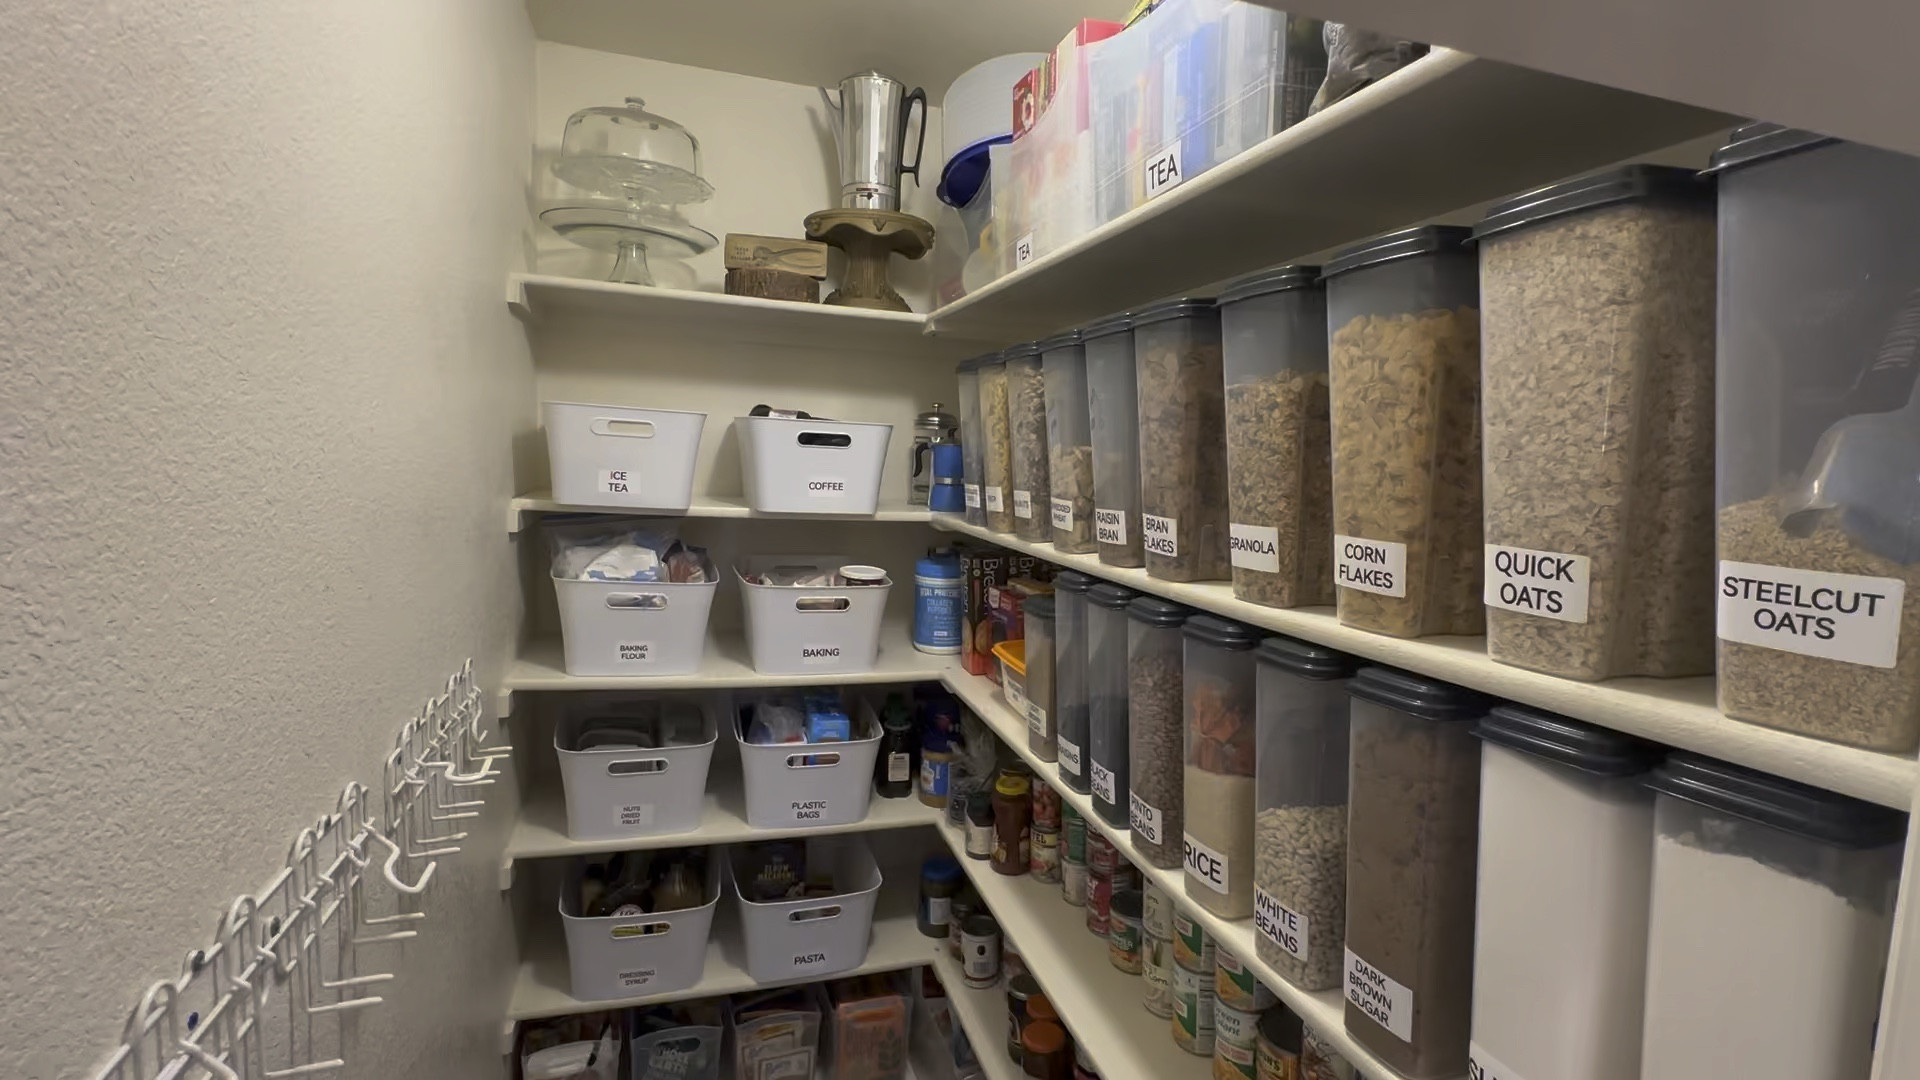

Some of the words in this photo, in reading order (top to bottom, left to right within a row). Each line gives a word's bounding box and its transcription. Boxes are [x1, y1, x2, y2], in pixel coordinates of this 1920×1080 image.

[1149, 153, 1178, 190] TEA
[1018, 242, 1030, 261] TEA
[608, 482, 628, 492] TEA
[610, 471, 627, 481] ICE
[809, 481, 844, 491] COFFEE
[1096, 511, 1120, 525] RAISIN
[1146, 517, 1169, 534] BRAN
[1099, 528, 1119, 542] BRAN
[1344, 543, 1386, 565] CORN
[1339, 563, 1393, 589] FLAKES
[1495, 550, 1575, 583] QUICK
[1500, 582, 1563, 614] OATS
[1722, 575, 1885, 617] STEELCUT
[1753, 607, 1836, 640] OATS
[620, 644, 648, 652] BAKING
[621, 652, 646, 660] FLOUR
[803, 647, 840, 658] BAKING
[791, 800, 827, 810] PLASTIC
[796, 810, 820, 819] BAGS
[1131, 794, 1153, 822] PINTO
[1184, 840, 1222, 885] RICE
[1256, 887, 1298, 932] WHITE
[1255, 909, 1298, 954] BEANS
[794, 953, 826, 966] PASTA
[1355, 959, 1386, 991] DARK
[1349, 970, 1392, 1012] BROWN
[1350, 988, 1390, 1028] SUGAR
